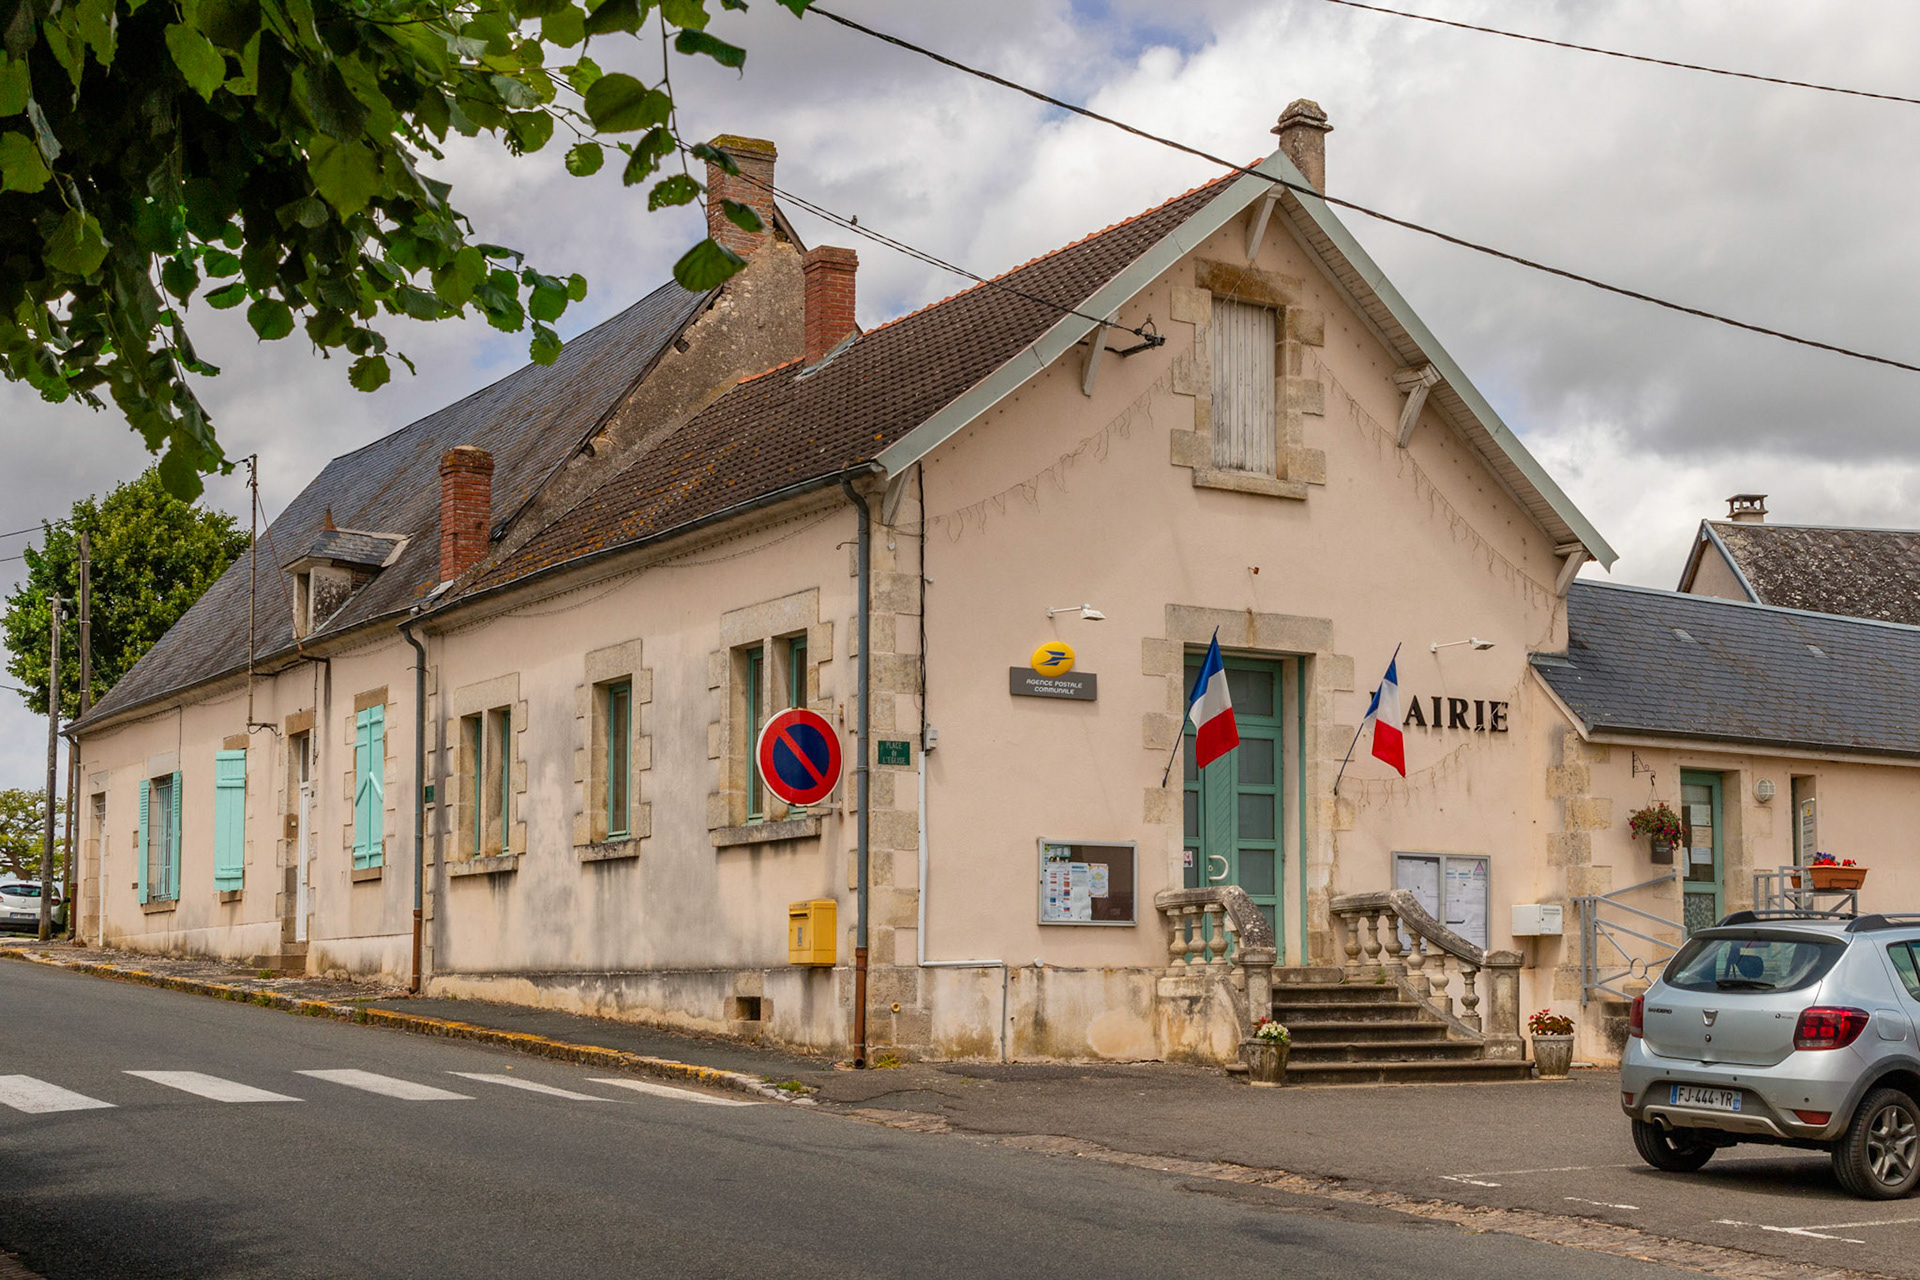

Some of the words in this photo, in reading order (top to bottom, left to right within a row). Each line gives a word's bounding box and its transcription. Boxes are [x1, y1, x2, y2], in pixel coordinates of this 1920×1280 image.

[1054, 681, 1083, 689] POSTALE
[1034, 686, 1075, 695] COMMUNALE
[1369, 691, 1509, 733] AIRIE
[885, 741, 903, 750] PLACE
